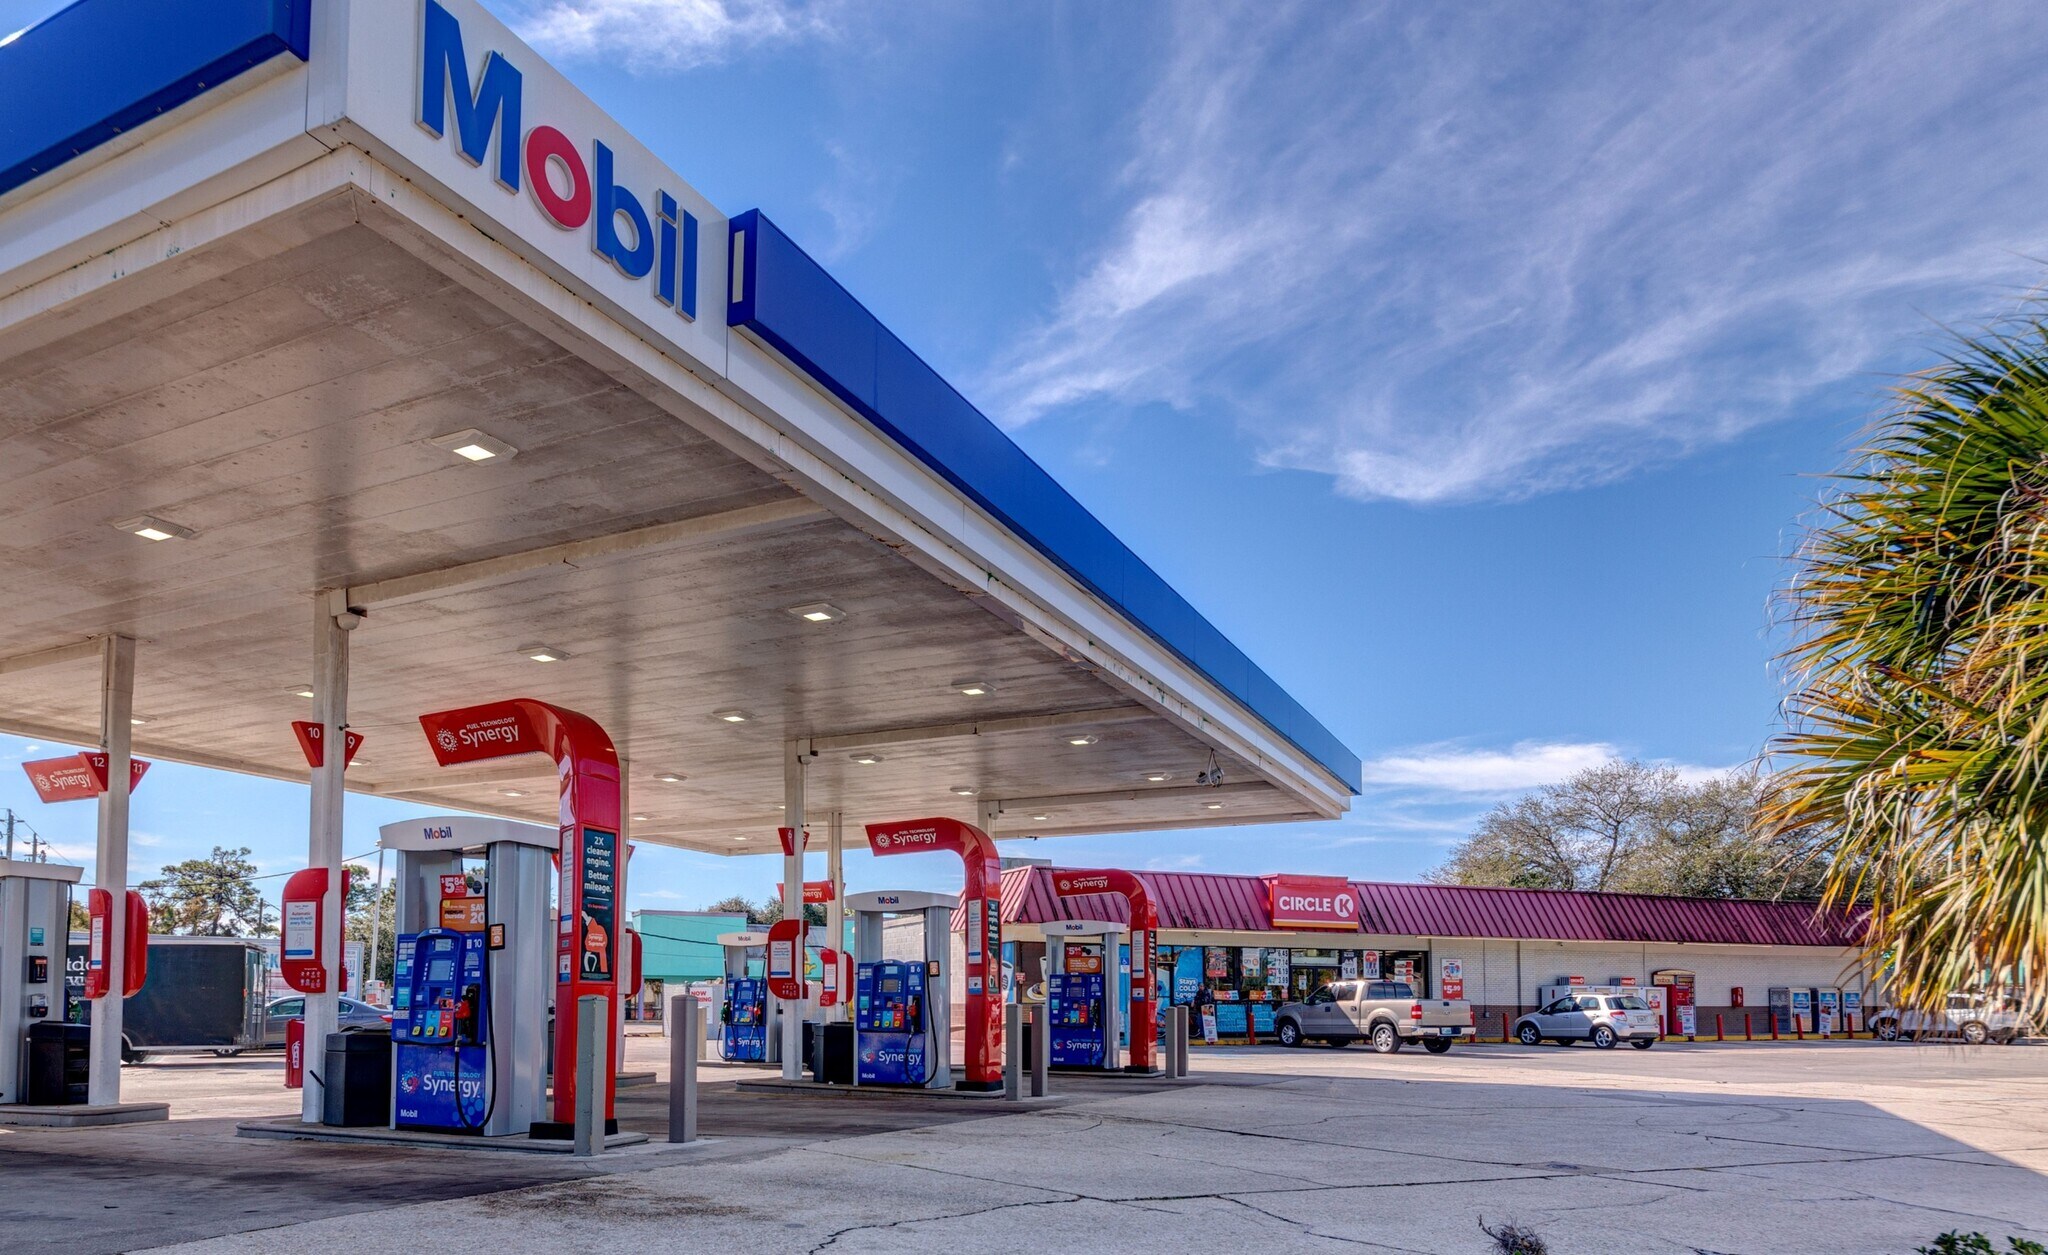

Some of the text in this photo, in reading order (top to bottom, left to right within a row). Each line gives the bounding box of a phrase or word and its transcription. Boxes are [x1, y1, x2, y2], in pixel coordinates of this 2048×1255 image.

[416, 0, 698, 323] Mobil
[480, 717, 515, 727] TECHNOLOGY
[308, 727, 320, 739] 10
[459, 725, 519, 748] Synergy
[347, 736, 355, 749] 9
[92, 757, 105, 767] 12
[133, 763, 143, 774] 11
[49, 773, 91, 790] Synergy
[424, 826, 453, 840] Mobil
[892, 832, 937, 846] Synergy
[594, 836, 604, 845] 2X
[586, 845, 611, 857] cleaner
[586, 857, 611, 868] engine.
[587, 870, 609, 881] Better
[1073, 880, 1108, 889] Synergy
[1279, 896, 1353, 917] CIRCLE K
[473, 938, 482, 948] 10
[423, 1074, 481, 1097] Synergy
[400, 1109, 418, 1118] Mobil
